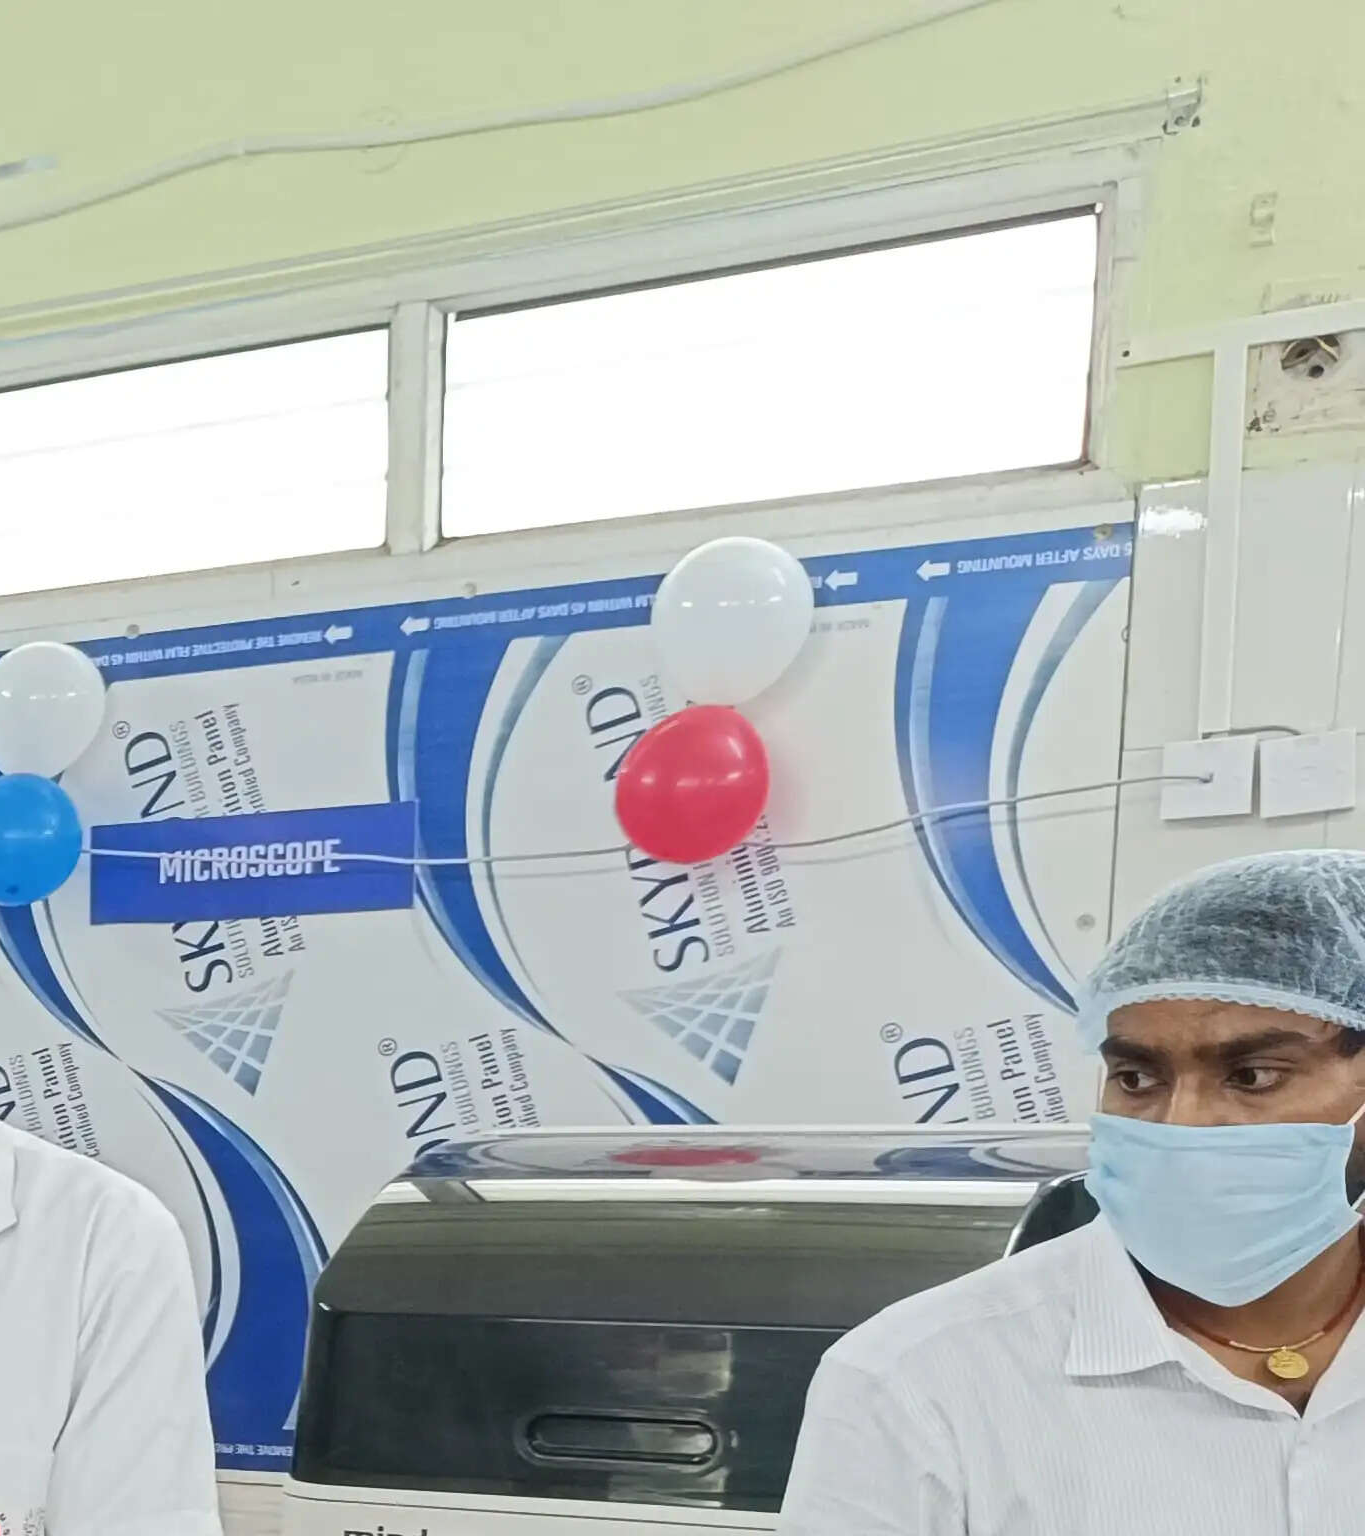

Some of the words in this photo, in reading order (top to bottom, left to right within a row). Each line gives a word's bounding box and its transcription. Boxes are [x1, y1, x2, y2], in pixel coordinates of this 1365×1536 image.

[957, 553, 1032, 574] MOUNTING
[1036, 549, 1080, 566] AFTER
[1083, 544, 1120, 561] DAYS
[433, 612, 497, 629] MOUNTING
[498, 607, 536, 623] AFTER
[537, 602, 568, 619] DAYS
[192, 638, 254, 657] PROTECTIVE
[256, 635, 275, 649] THE
[194, 710, 227, 766] Panel
[222, 703, 251, 765] Company
[159, 839, 342, 884] MICROSCOPE
[696, 872, 735, 958] SOLUTION
[765, 879, 790, 906] ISO
[31, 1047, 62, 1099] Panel
[58, 1042, 84, 1101] Company
[468, 1033, 504, 1090] Panel
[499, 1028, 528, 1093] Company
[953, 1027, 996, 1120] BUILDINGS
[986, 1018, 1027, 1081] Panel
[1022, 1013, 1057, 1083] Company
[8, 1054, 43, 1132] BUILDINGS
[441, 1041, 479, 1127] BUILDINGS
